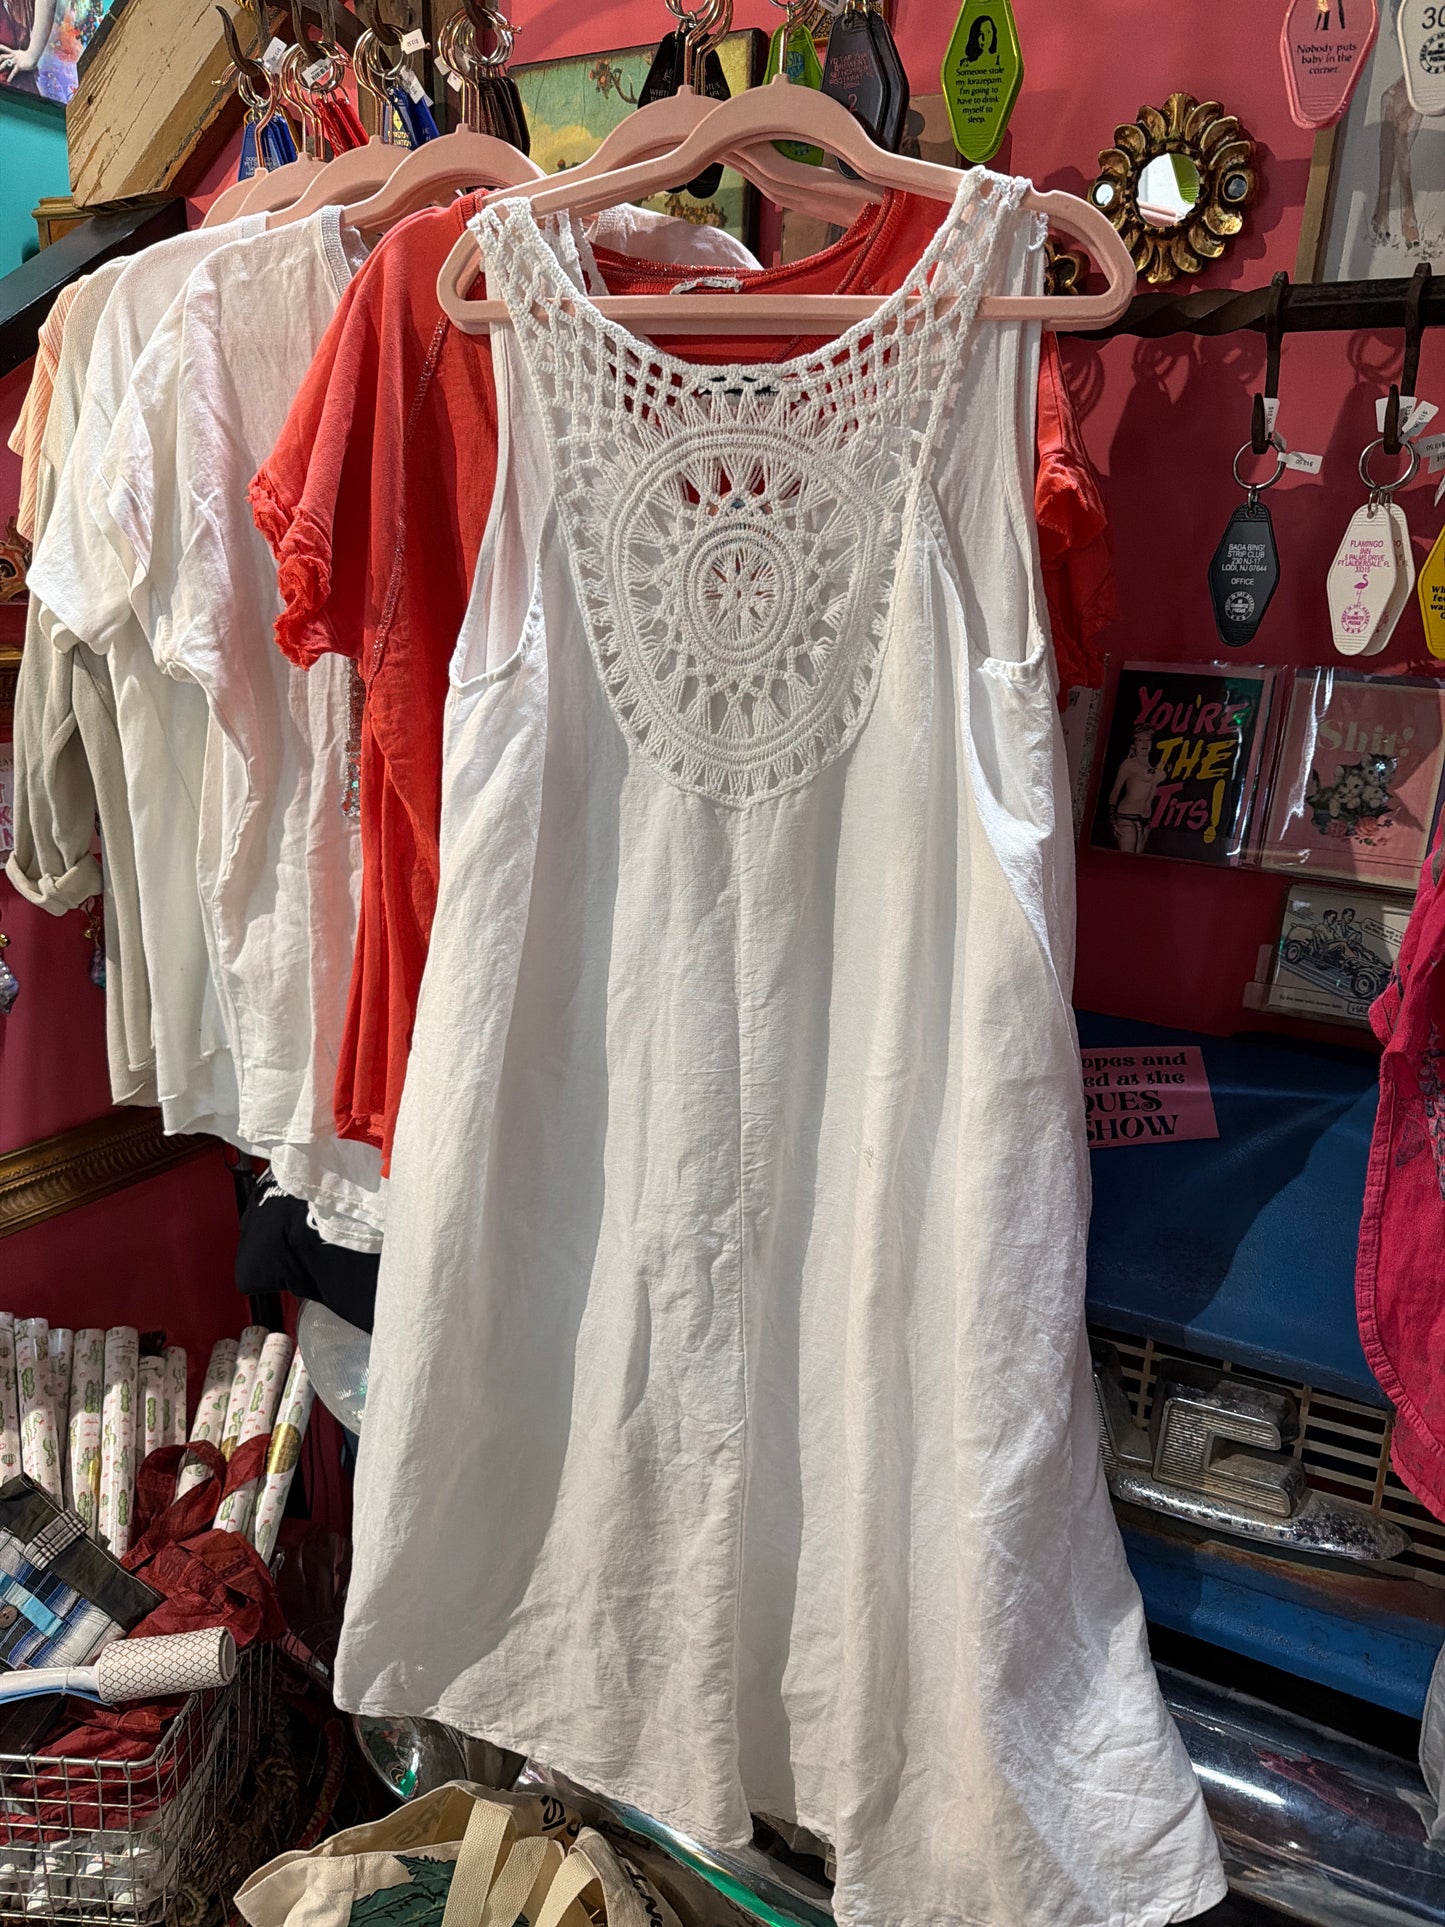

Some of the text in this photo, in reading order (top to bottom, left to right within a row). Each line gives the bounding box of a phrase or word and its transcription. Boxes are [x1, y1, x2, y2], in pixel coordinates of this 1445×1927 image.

[1297, 43, 1357, 55] Nobody puts
[1302, 53, 1352, 65] baby in the
[956, 68, 987, 76] Someone
[956, 79, 965, 87] my
[960, 87, 970, 95] I'm
[971, 88, 990, 97] going
[957, 97, 972, 105] have
[982, 95, 999, 103] drink
[962, 105, 984, 115] myself
[1350, 540, 1384, 548] FLAMINGO
[1317, 719, 1415, 758] Shit!
[1156, 736, 1238, 782] THE
[1142, 1052, 1187, 1066] and
[1116, 1073, 1140, 1087] at
[1146, 1070, 1185, 1085] the
